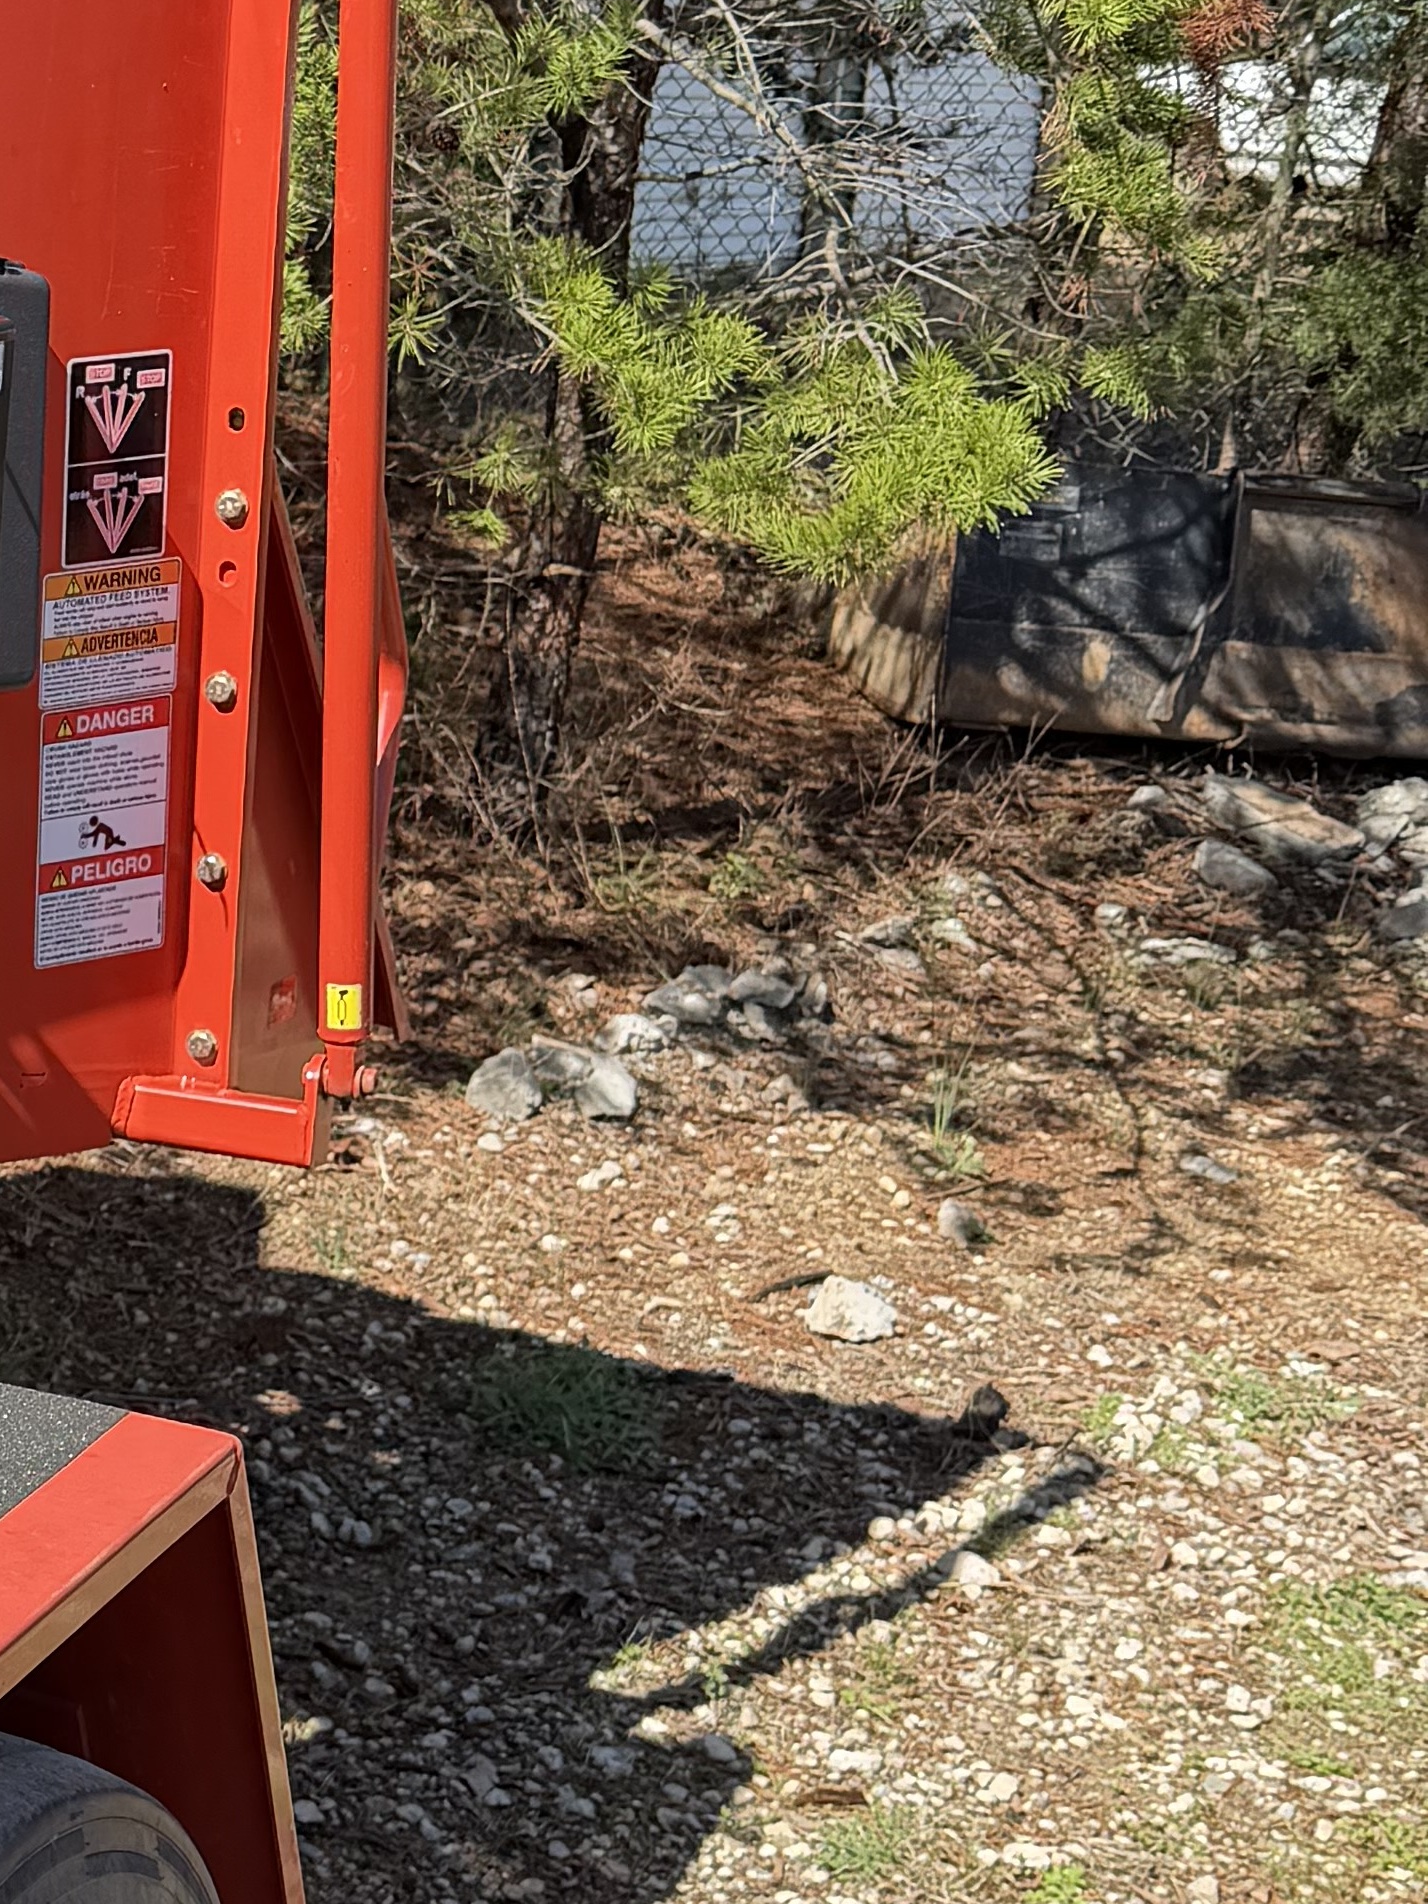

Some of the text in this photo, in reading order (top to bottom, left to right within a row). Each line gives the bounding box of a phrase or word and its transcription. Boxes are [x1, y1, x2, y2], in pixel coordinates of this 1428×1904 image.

[124, 367, 132, 381] F
[76, 386, 86, 398] R
[84, 566, 161, 591] WARNING
[52, 594, 107, 610] AUTOMATED
[109, 591, 132, 602] FEED
[81, 628, 158, 653] ADVERTENCIA
[76, 704, 154, 734] DANGER
[71, 854, 152, 884] PELIGRO
